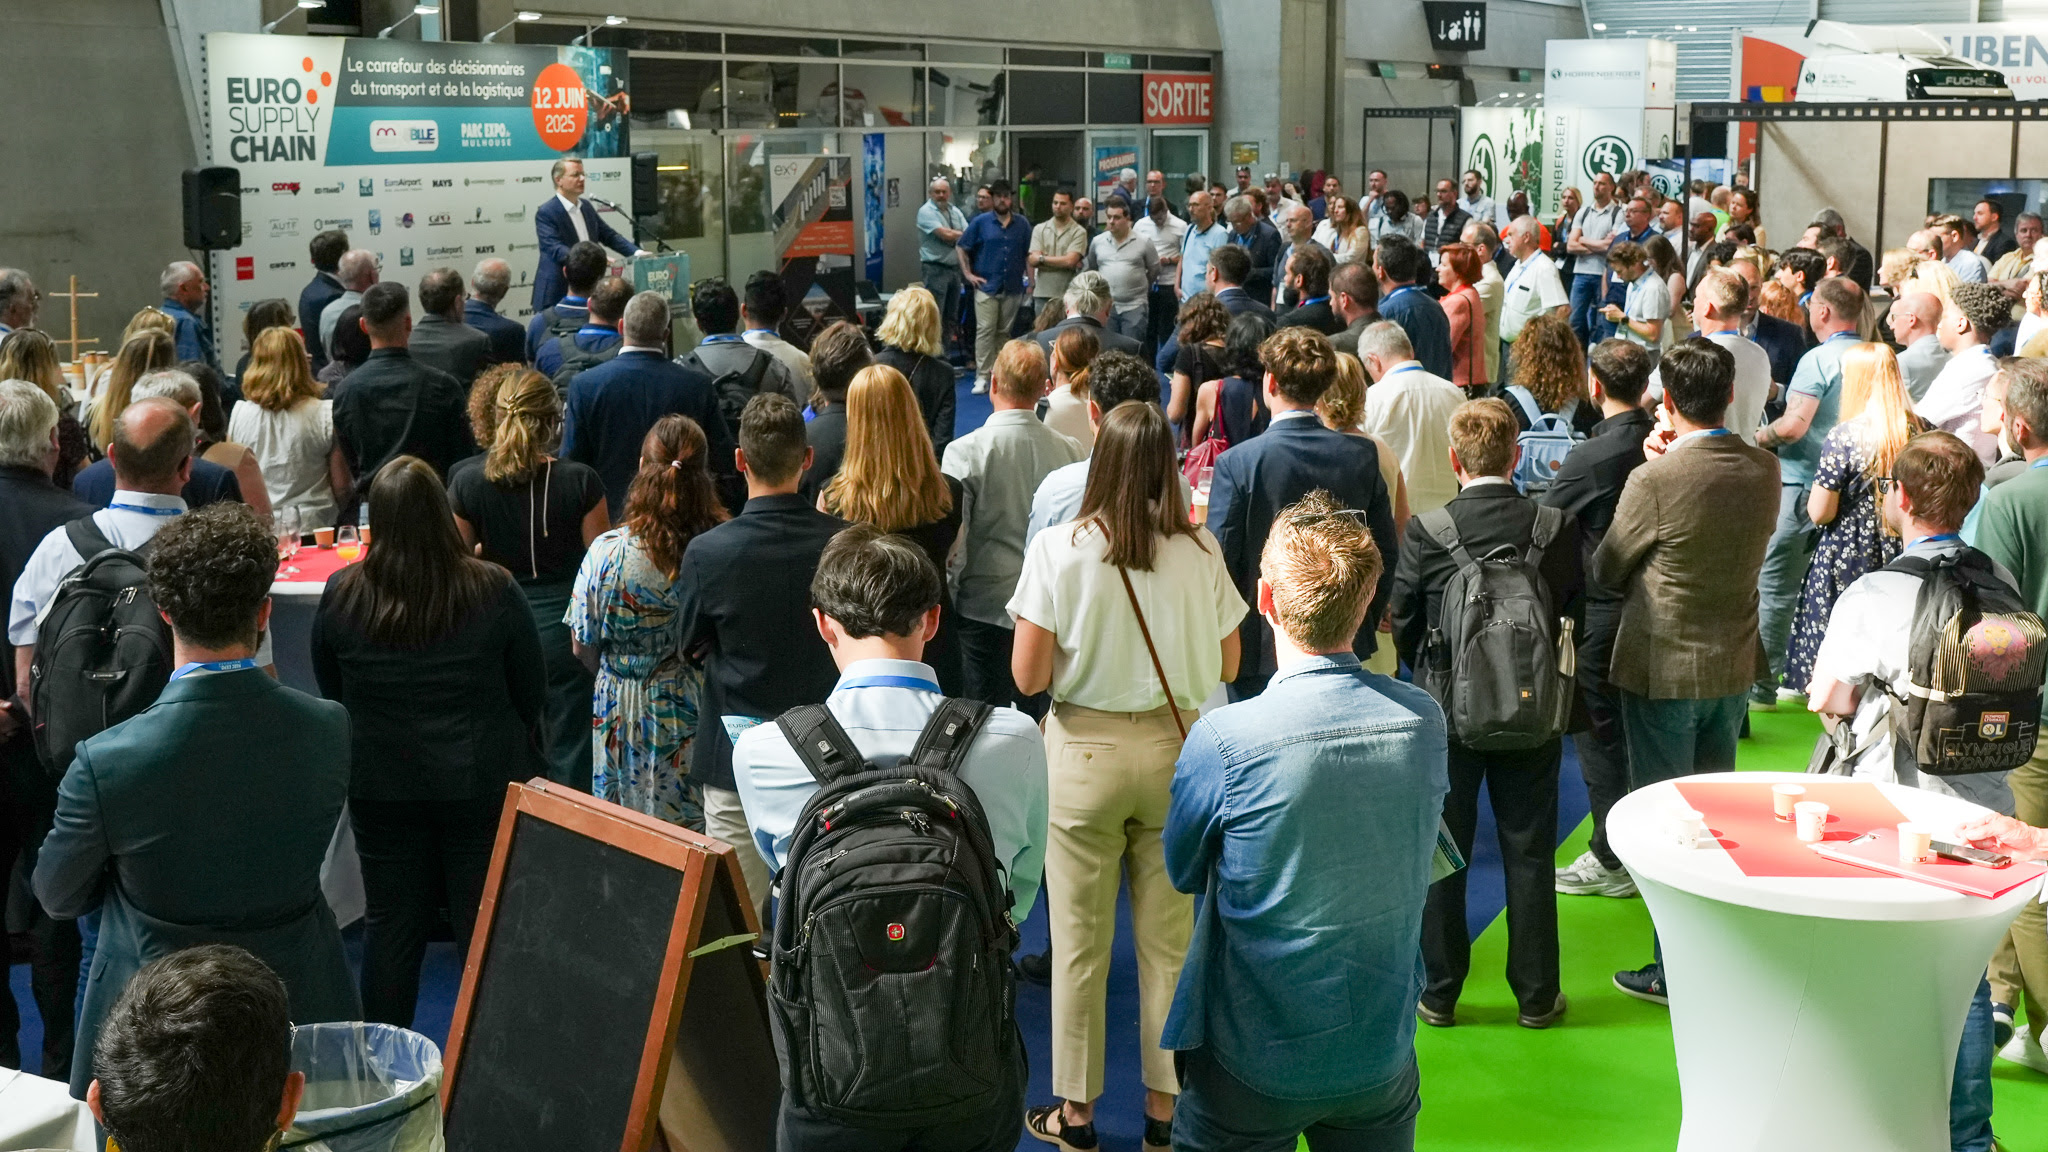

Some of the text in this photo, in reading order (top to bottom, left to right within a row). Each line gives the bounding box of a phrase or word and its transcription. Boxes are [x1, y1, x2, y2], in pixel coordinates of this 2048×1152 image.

[347, 57, 526, 76] Le carrefour des décisionnaires
[1946, 77, 1986, 86] FUCHS
[2011, 76, 2021, 84] LE
[227, 77, 302, 104] EURO
[351, 79, 525, 100] du transport et de la logistique
[533, 87, 585, 109] 12 JUIN
[1147, 81, 1211, 117] SORTIE
[229, 106, 320, 133] SUPPLY
[545, 114, 576, 133] 2025
[461, 123, 483, 138] PARC
[484, 123, 506, 138] EXPO
[230, 135, 316, 164] CHAIN
[461, 139, 512, 147] MULHOUSE
[432, 179, 452, 187] HAYS
[475, 245, 495, 254] HAYS
[647, 270, 669, 281] EURO
[1945, 739, 2031, 757] OLYMPIQUE
[1943, 752, 2029, 770] LYONNAIS
